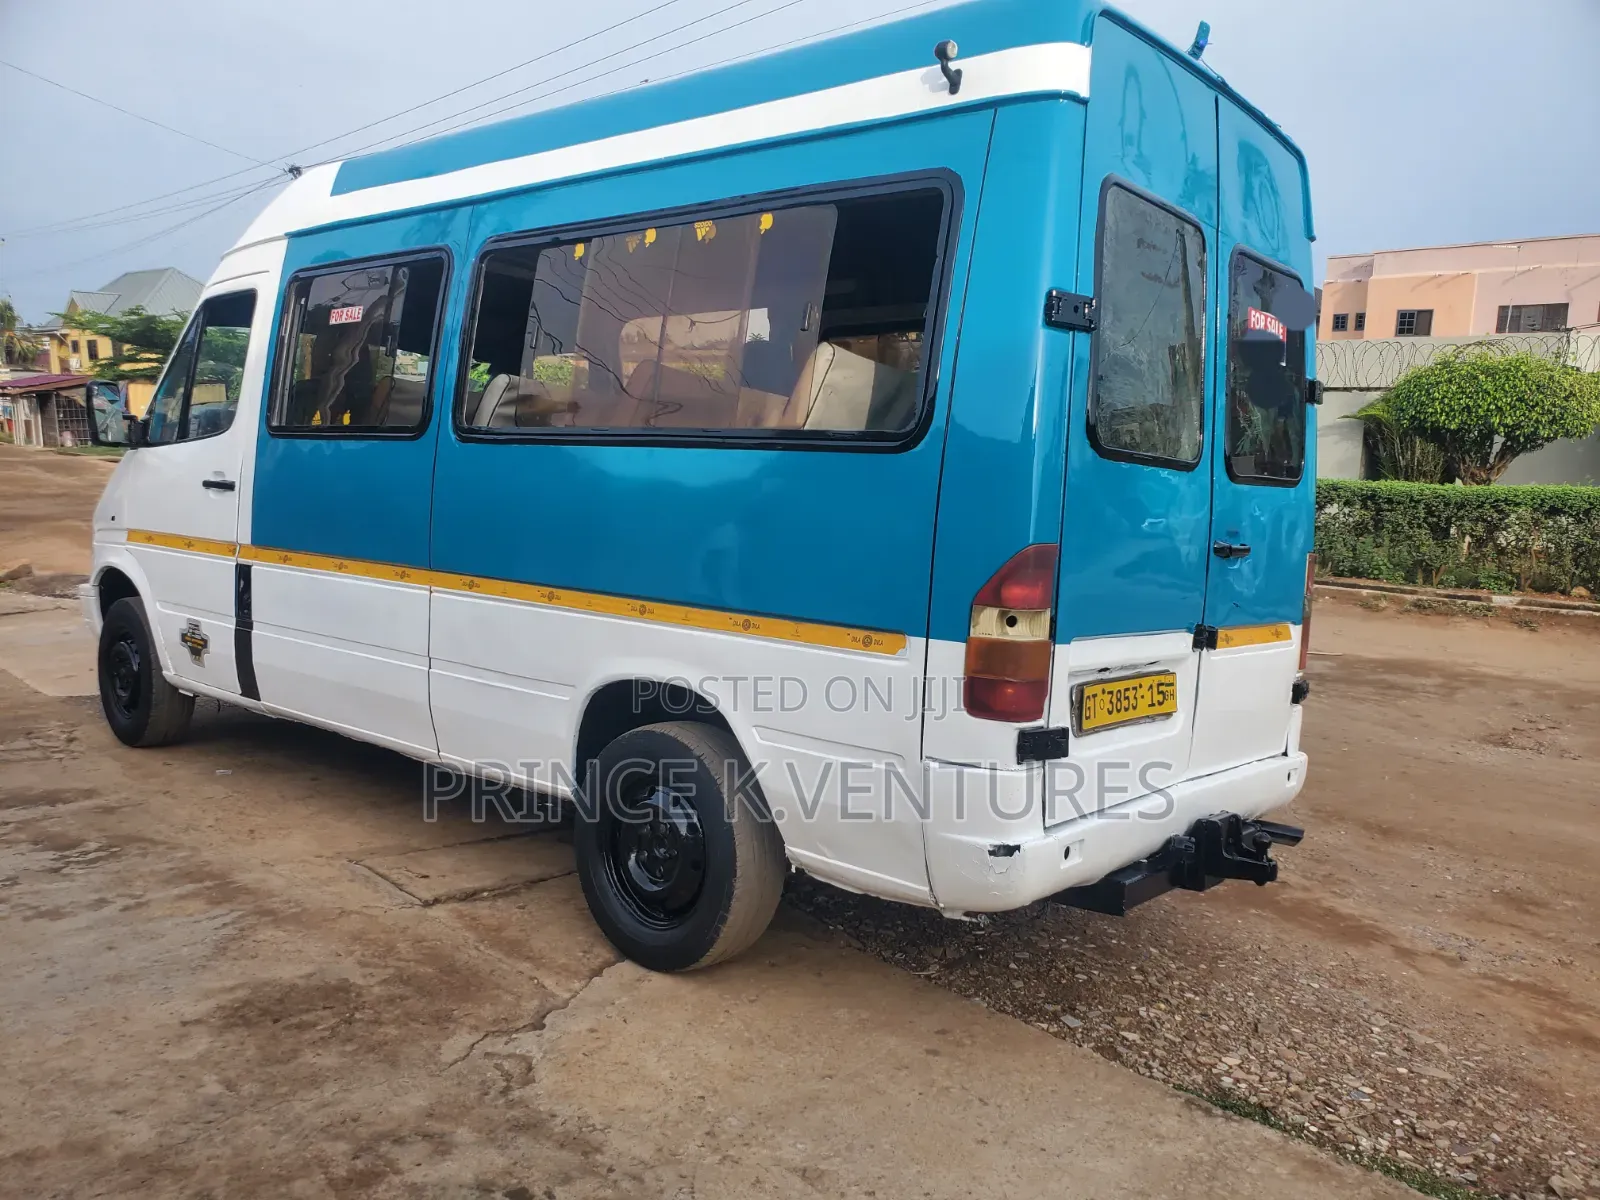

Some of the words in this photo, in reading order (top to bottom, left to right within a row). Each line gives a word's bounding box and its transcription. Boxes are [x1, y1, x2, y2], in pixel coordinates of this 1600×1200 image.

[331, 311, 344, 322] FOR
[345, 307, 362, 320] SALE
[1250, 310, 1266, 330] FOR
[1267, 317, 1284, 340] SALE
[1085, 693, 1098, 720] GT
[1165, 690, 1175, 700] GH
